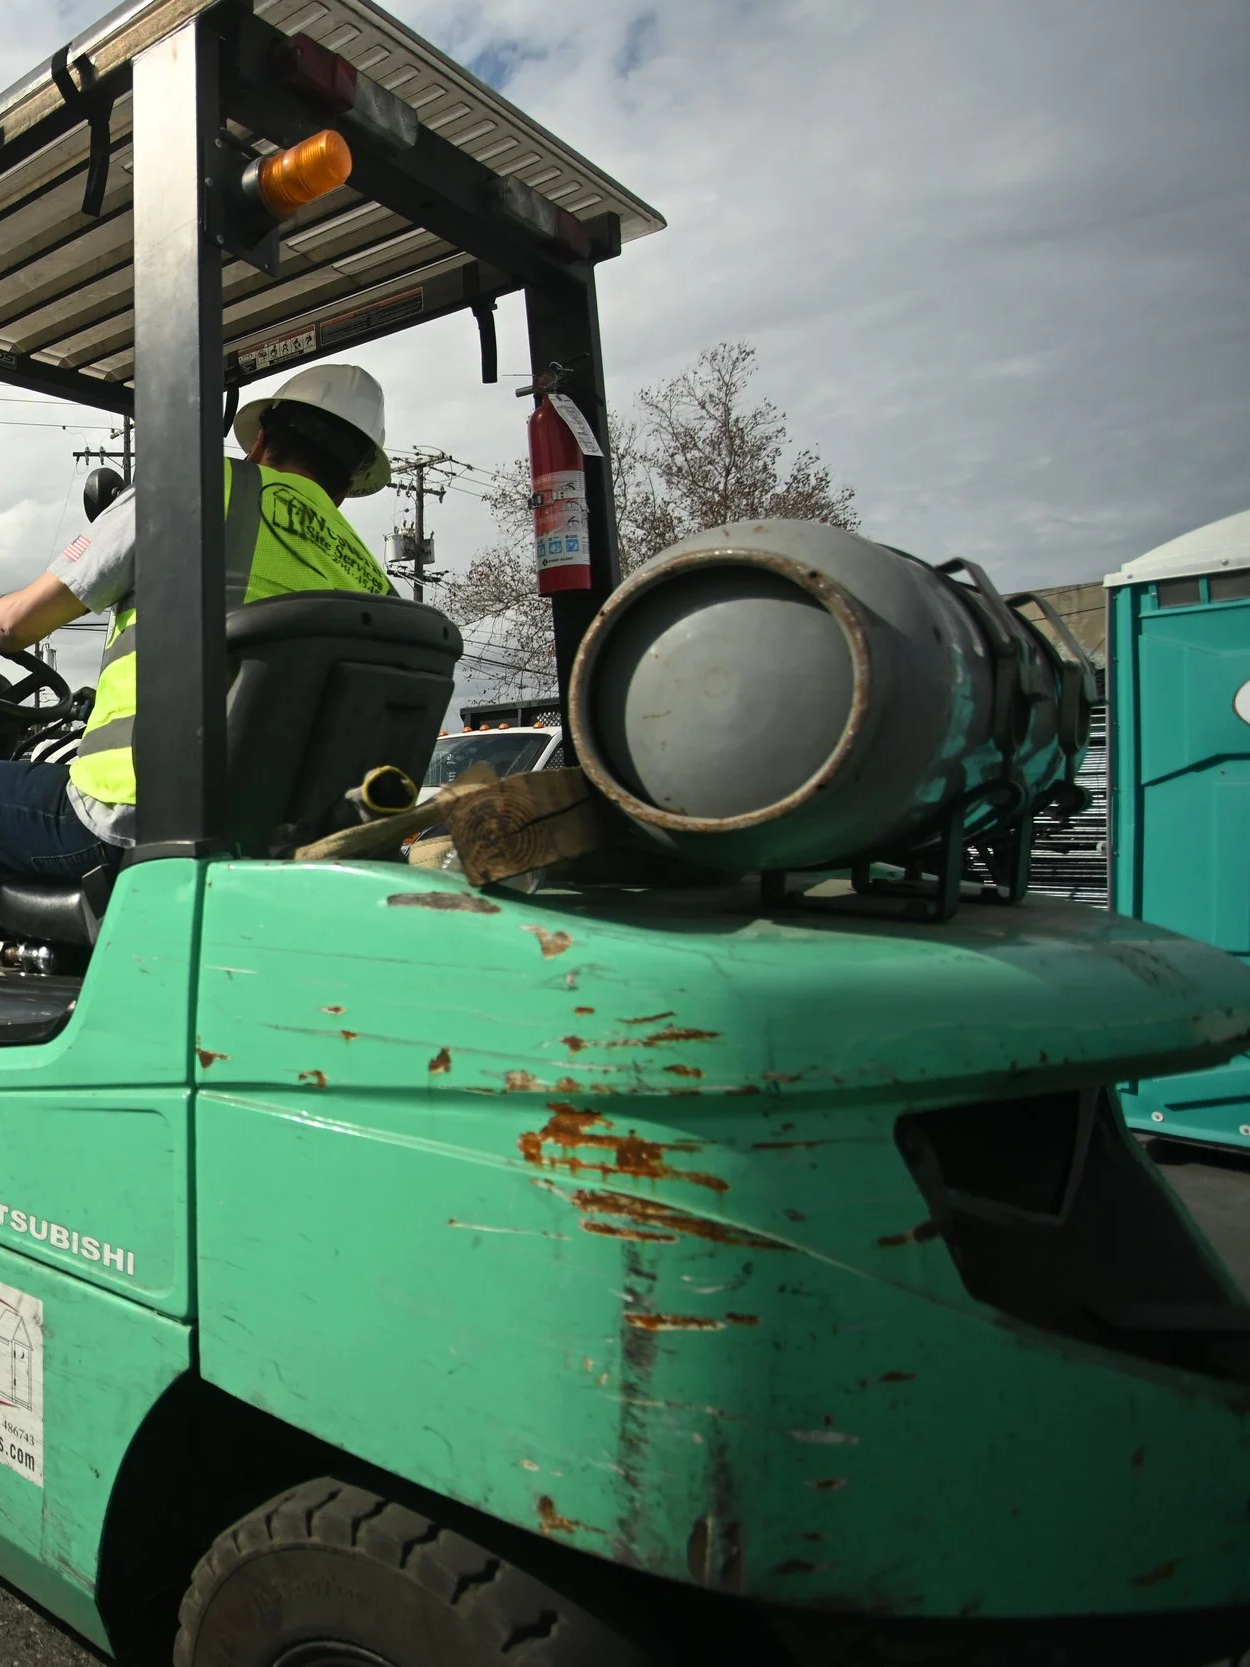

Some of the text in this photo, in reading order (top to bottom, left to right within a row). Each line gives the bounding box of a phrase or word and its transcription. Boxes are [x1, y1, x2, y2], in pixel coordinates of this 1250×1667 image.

[306, 525, 332, 551] Site
[335, 544, 383, 590] Services
[1, 1417, 35, 1446] 486743
